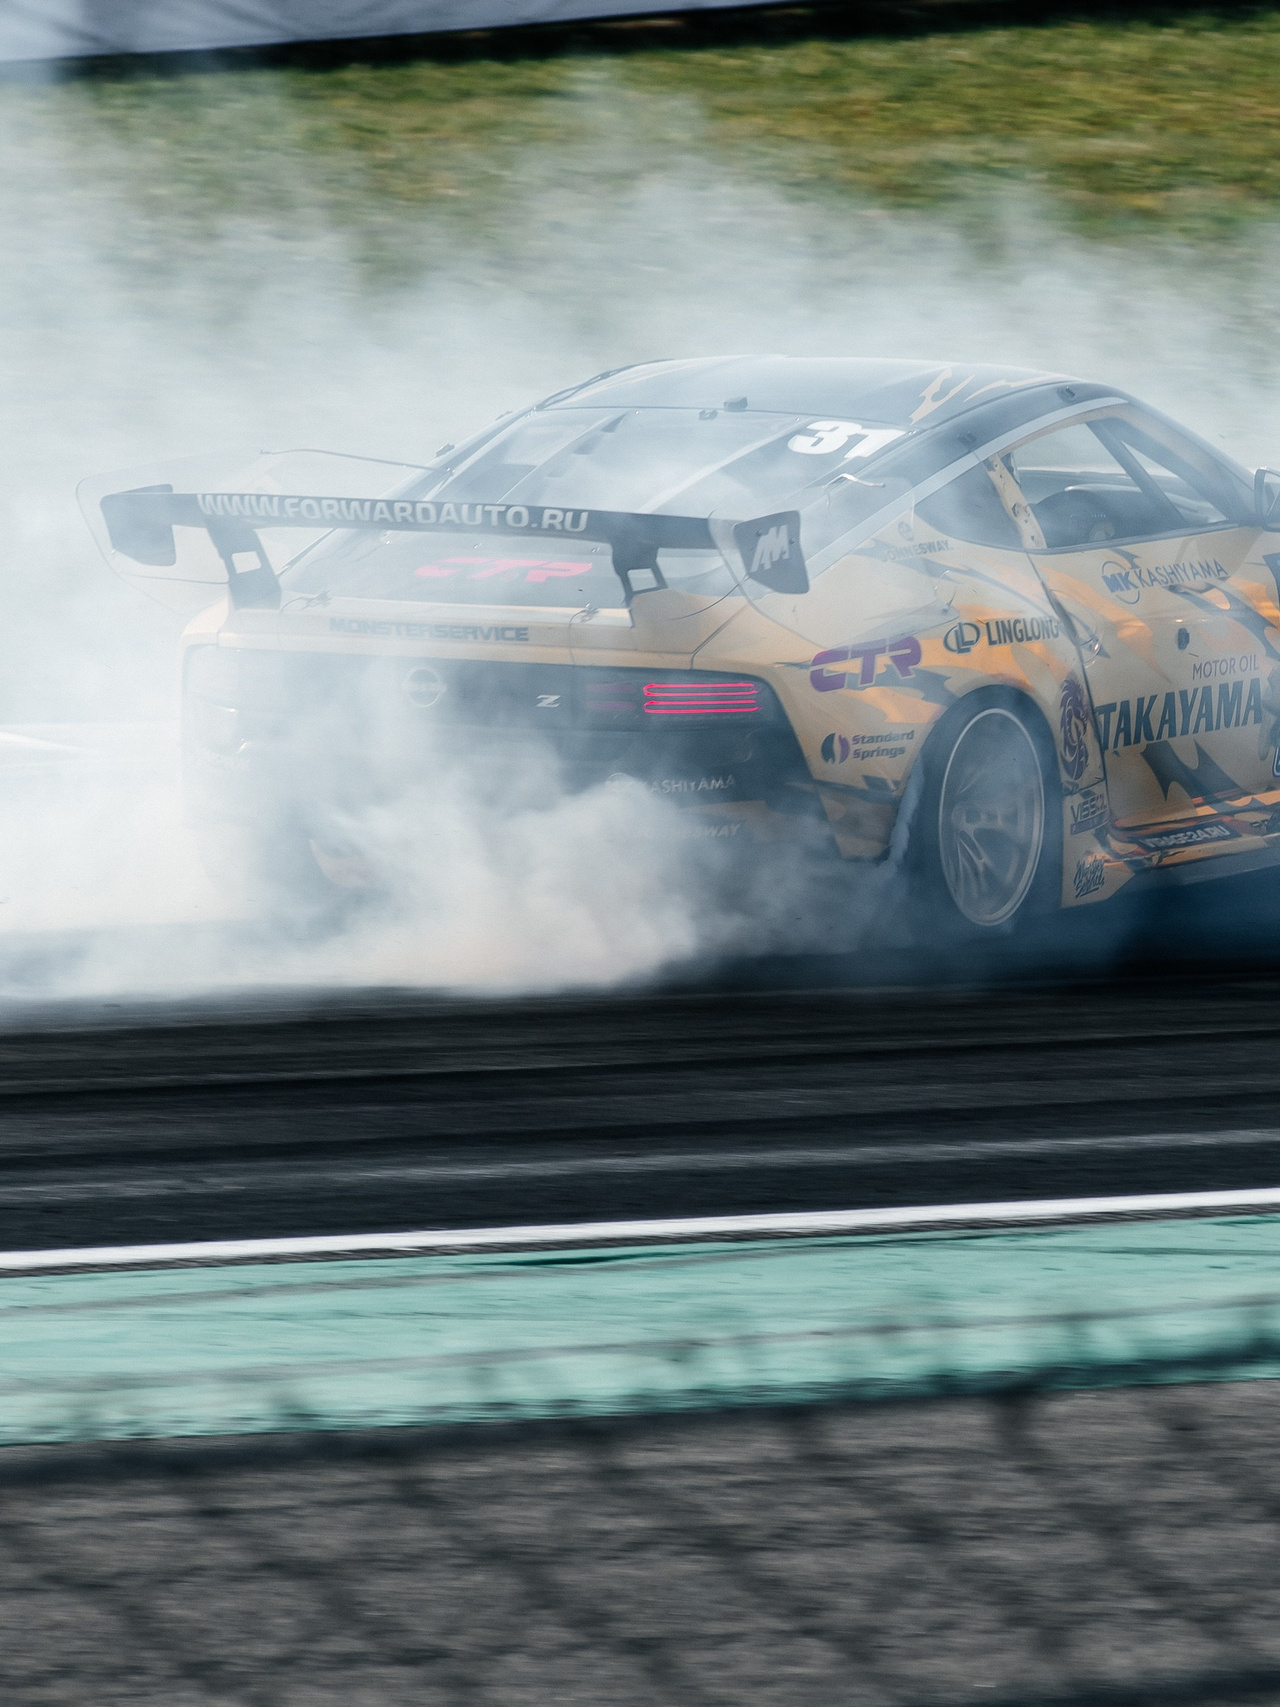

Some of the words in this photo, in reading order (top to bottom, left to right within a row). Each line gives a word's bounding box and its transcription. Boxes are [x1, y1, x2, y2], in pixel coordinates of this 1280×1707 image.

[787, 420, 906, 459] 31
[197, 493, 589, 533] WWW.FORWARDAUTO.RU
[1102, 570, 1139, 594] MK
[1134, 558, 1230, 588] KASHIYAMA
[330, 617, 529, 642] MONSTERSERVICE
[985, 617, 1060, 647] LINGLONG
[1192, 659, 1235, 680] MOTOR
[1239, 654, 1259, 673] OIL
[535, 694, 561, 708] Z
[1094, 677, 1263, 750] TAKAYAMA
[851, 729, 915, 746] Standard
[852, 743, 906, 761] Springs
